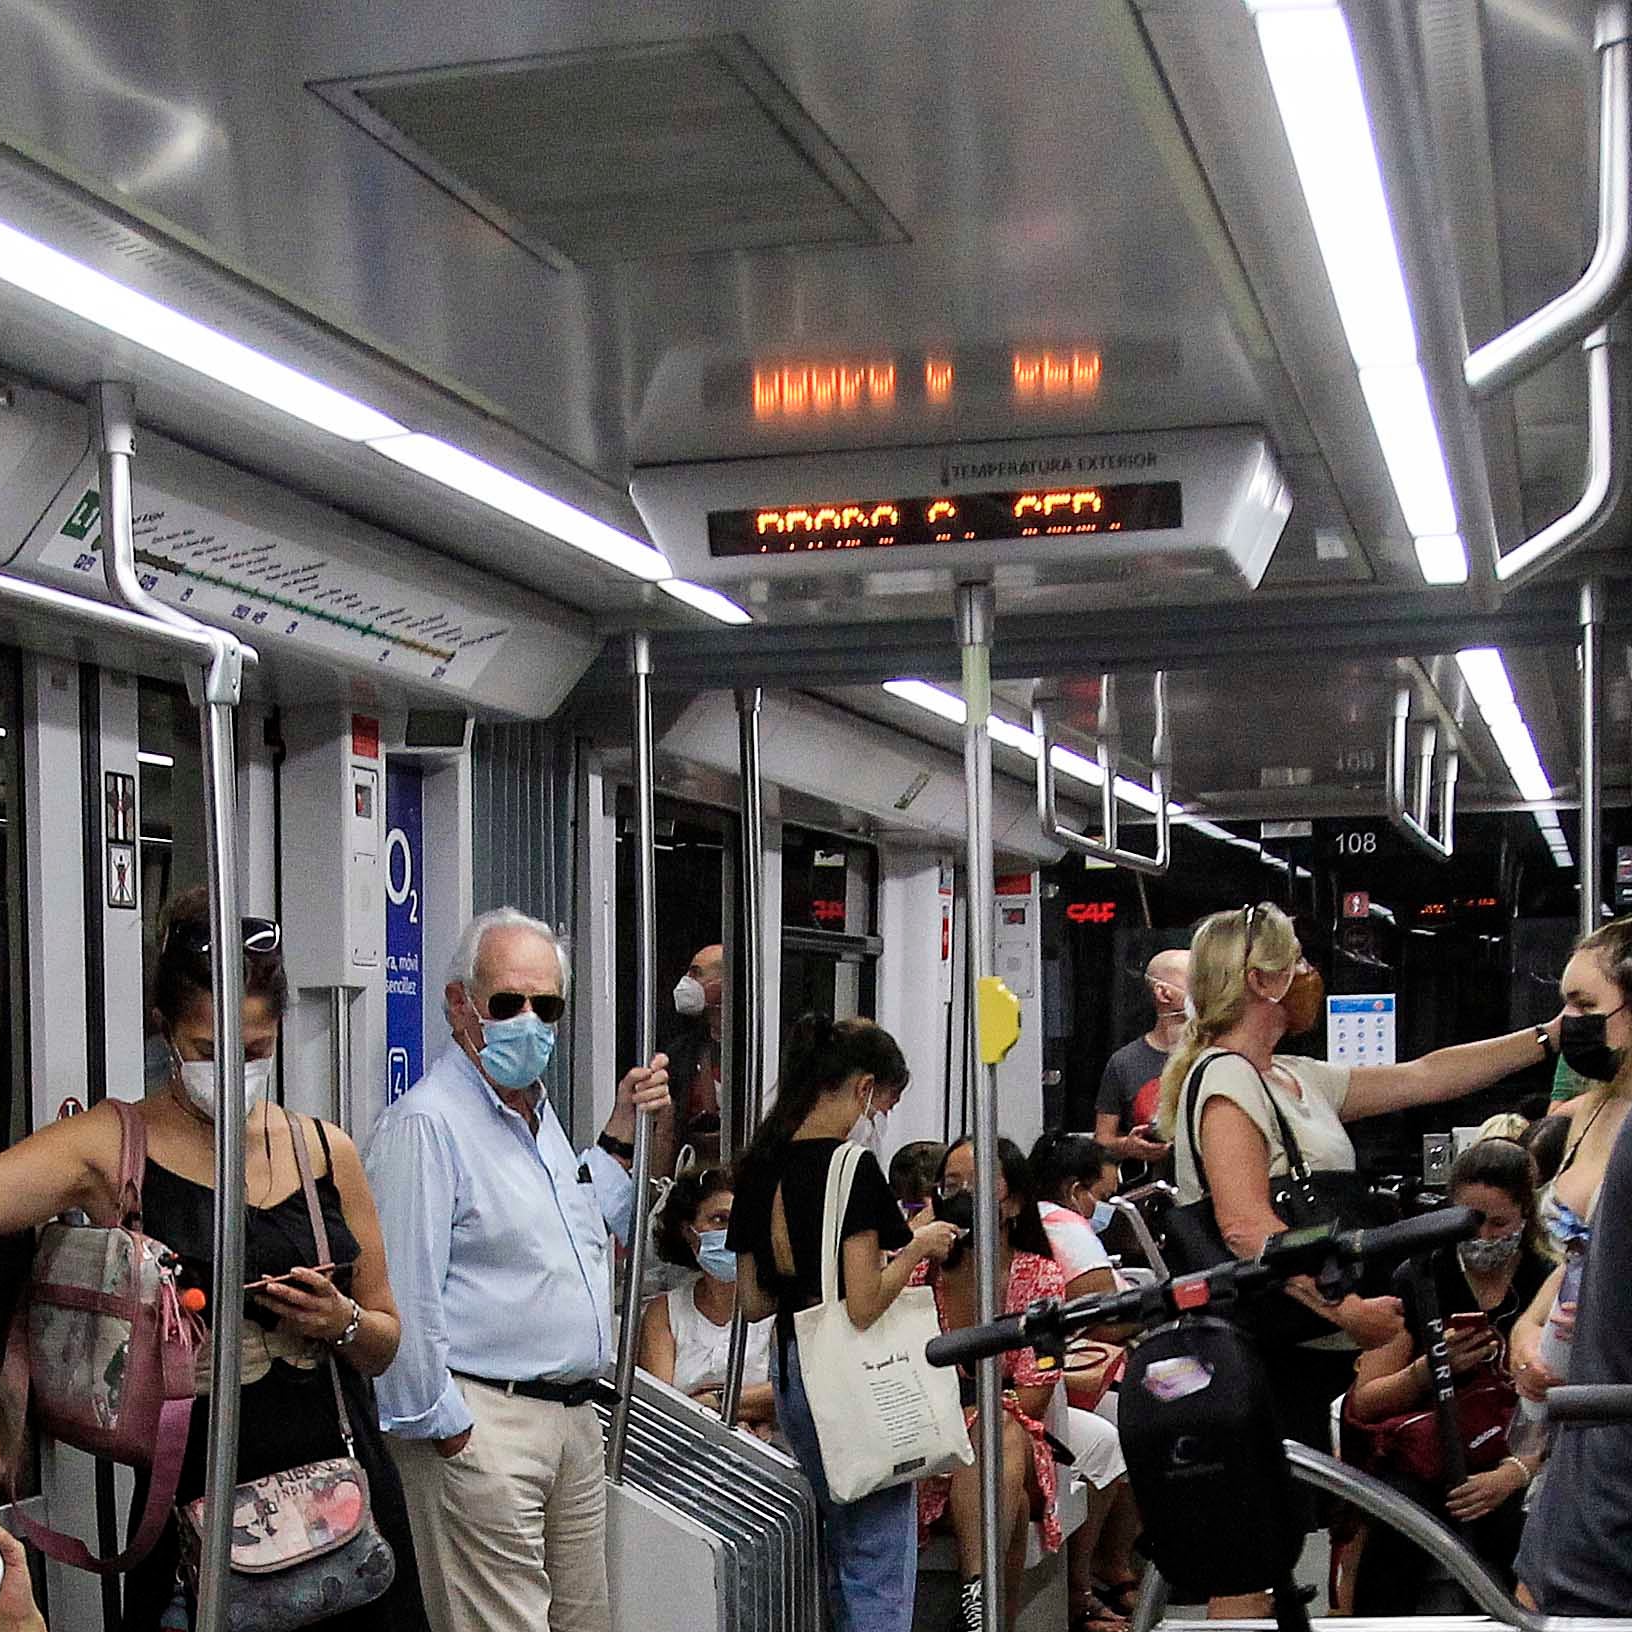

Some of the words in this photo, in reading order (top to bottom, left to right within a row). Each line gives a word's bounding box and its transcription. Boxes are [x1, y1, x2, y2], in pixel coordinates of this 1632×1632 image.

[952, 457, 1072, 479] TEMPERATURA
[1078, 452, 1157, 472] EXTERIOR
[1335, 832, 1377, 854] 108
[1067, 902, 1116, 923] CAF
[1427, 1318, 1455, 1401] PURE
